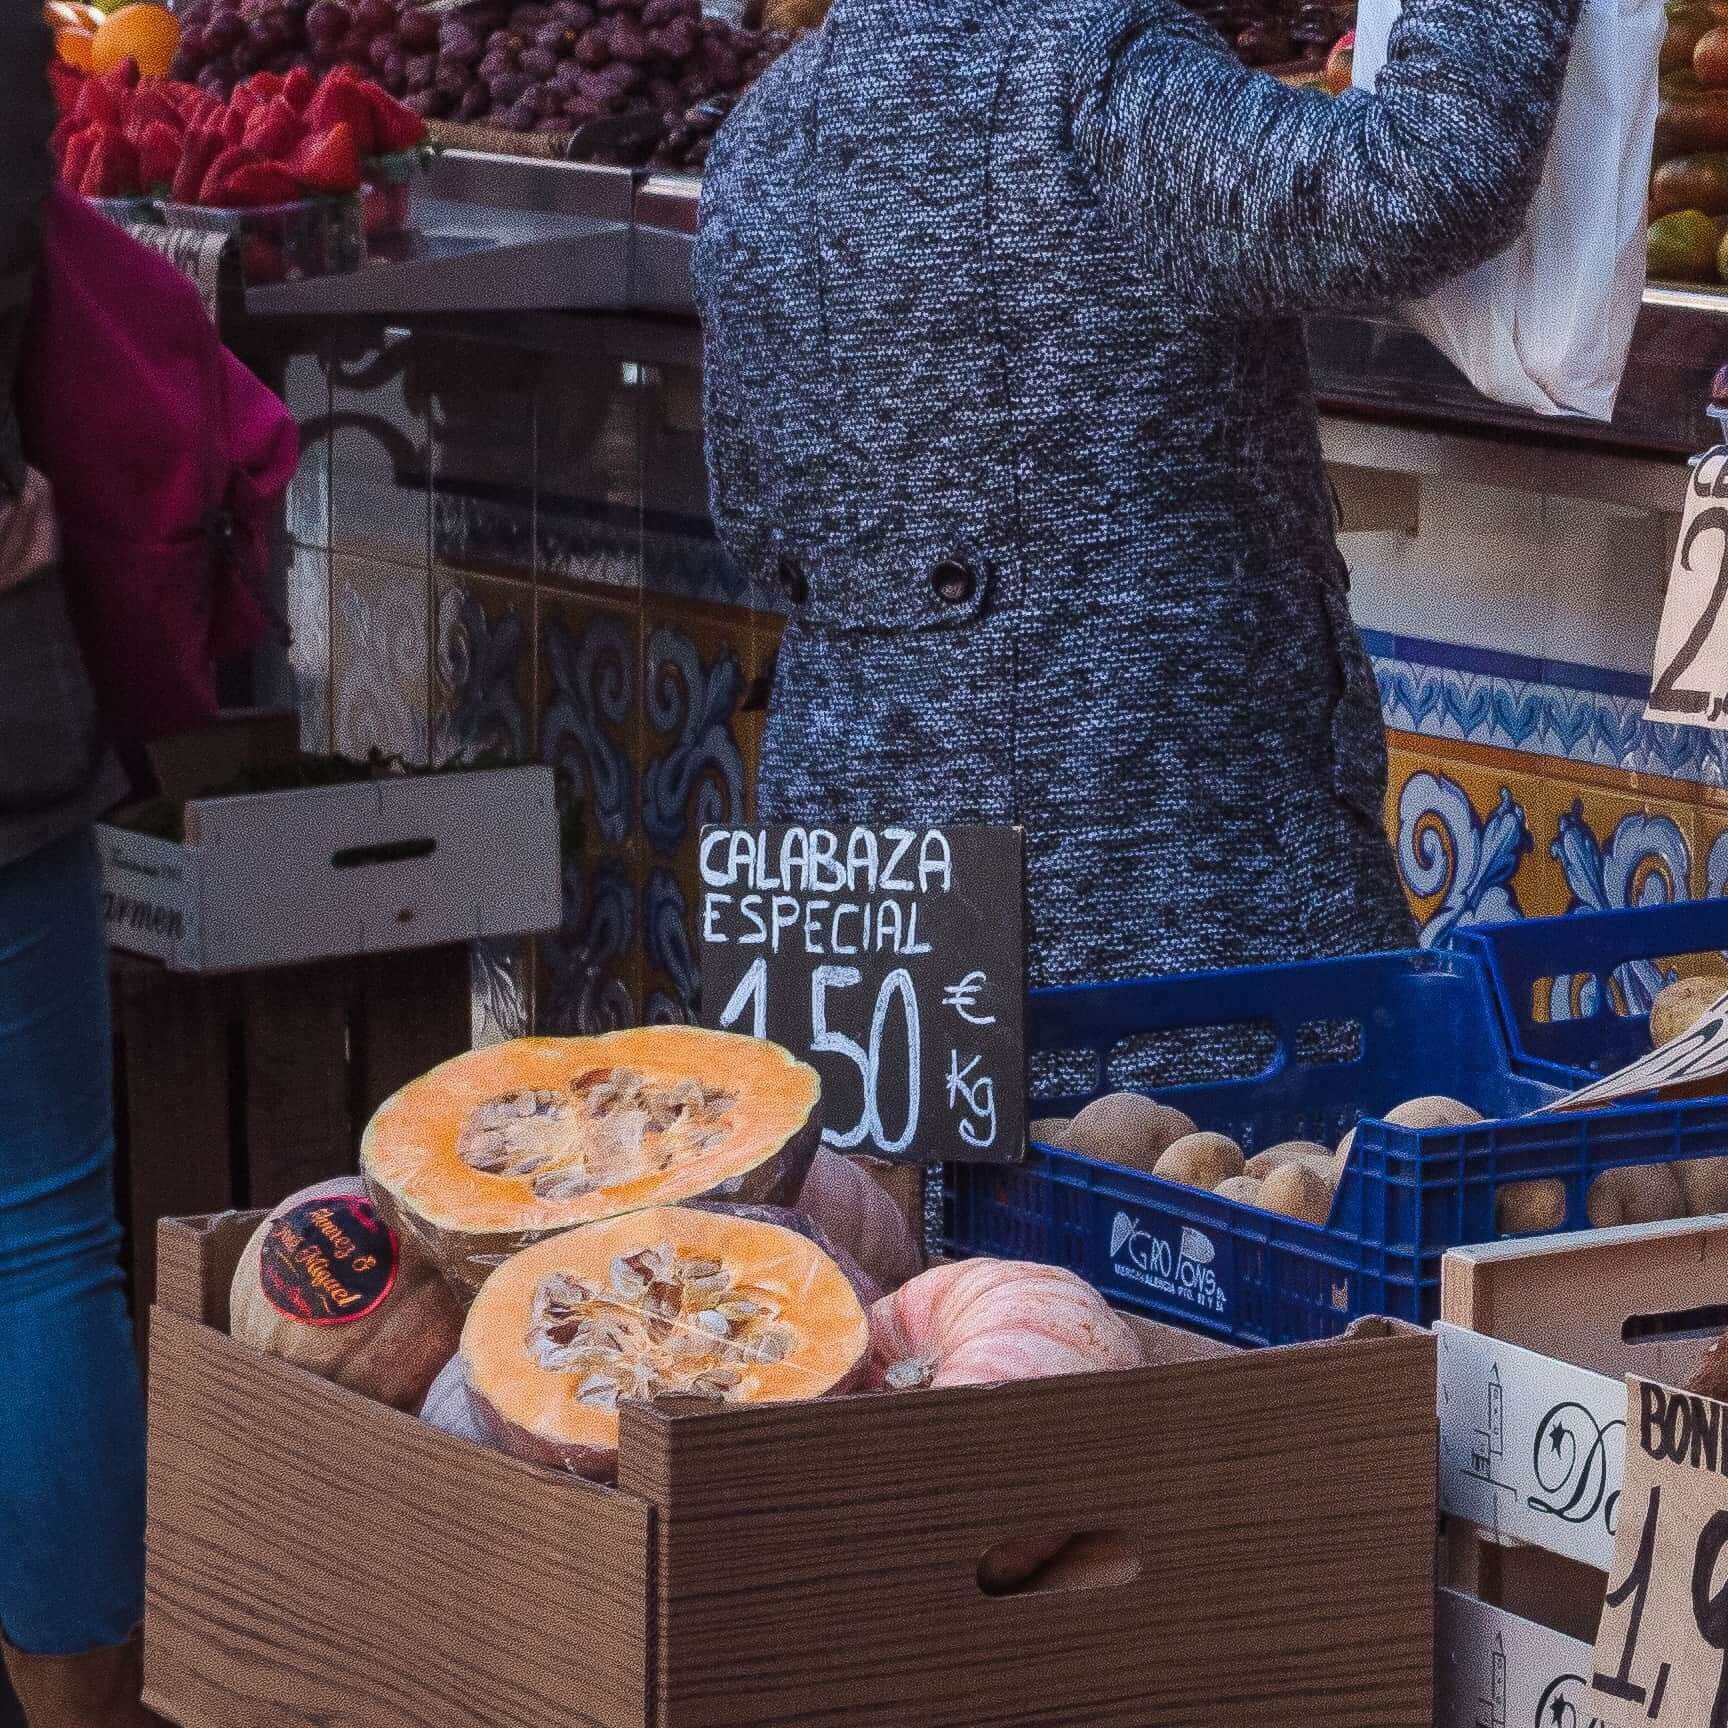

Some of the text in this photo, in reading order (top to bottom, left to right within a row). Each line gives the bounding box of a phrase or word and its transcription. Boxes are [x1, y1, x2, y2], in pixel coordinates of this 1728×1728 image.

[700, 826, 952, 894] CALABAZA
[702, 891, 933, 955] ESPECIAL
[942, 970, 996, 1025] €
[1174, 1225, 1217, 1297] PONS
